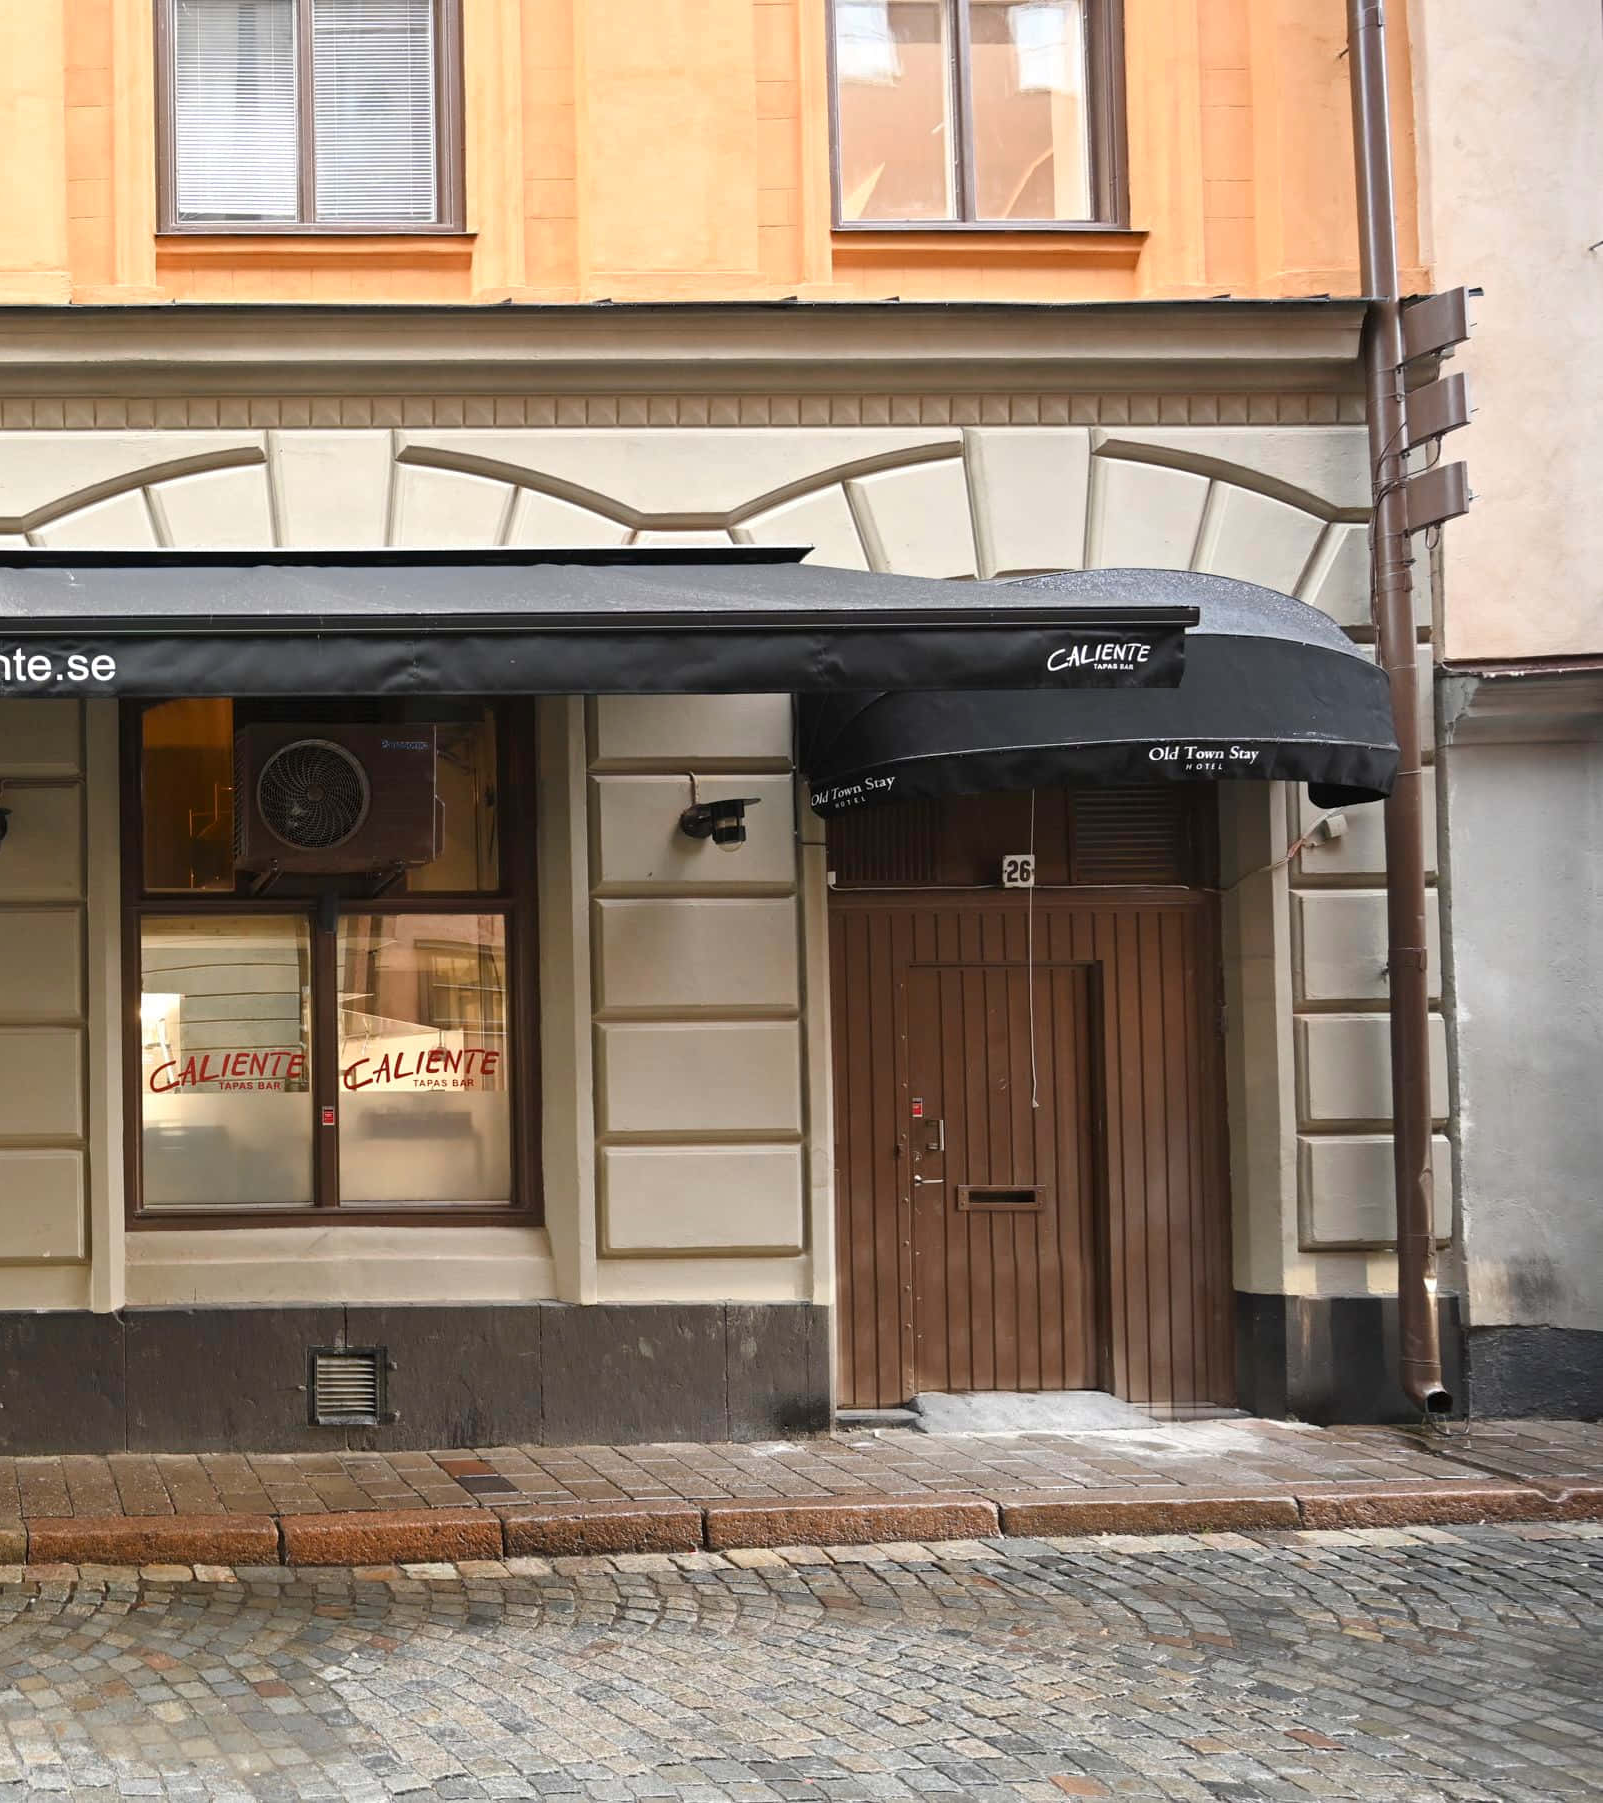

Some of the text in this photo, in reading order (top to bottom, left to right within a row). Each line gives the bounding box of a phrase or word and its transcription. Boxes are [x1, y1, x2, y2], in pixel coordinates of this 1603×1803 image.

[1047, 643, 1151, 671] CALIENTE
[1148, 745, 1259, 764] Old Town Stay
[811, 776, 896, 806] Old Town Stay
[835, 796, 866, 808] HOTEL
[1006, 859, 1031, 883] 26
[149, 1051, 306, 1093] CALIENTE
[343, 1048, 500, 1090] CALIENTE
[218, 1080, 281, 1090] TAPAS BAR
[413, 1078, 475, 1088] TAPAS BAR
